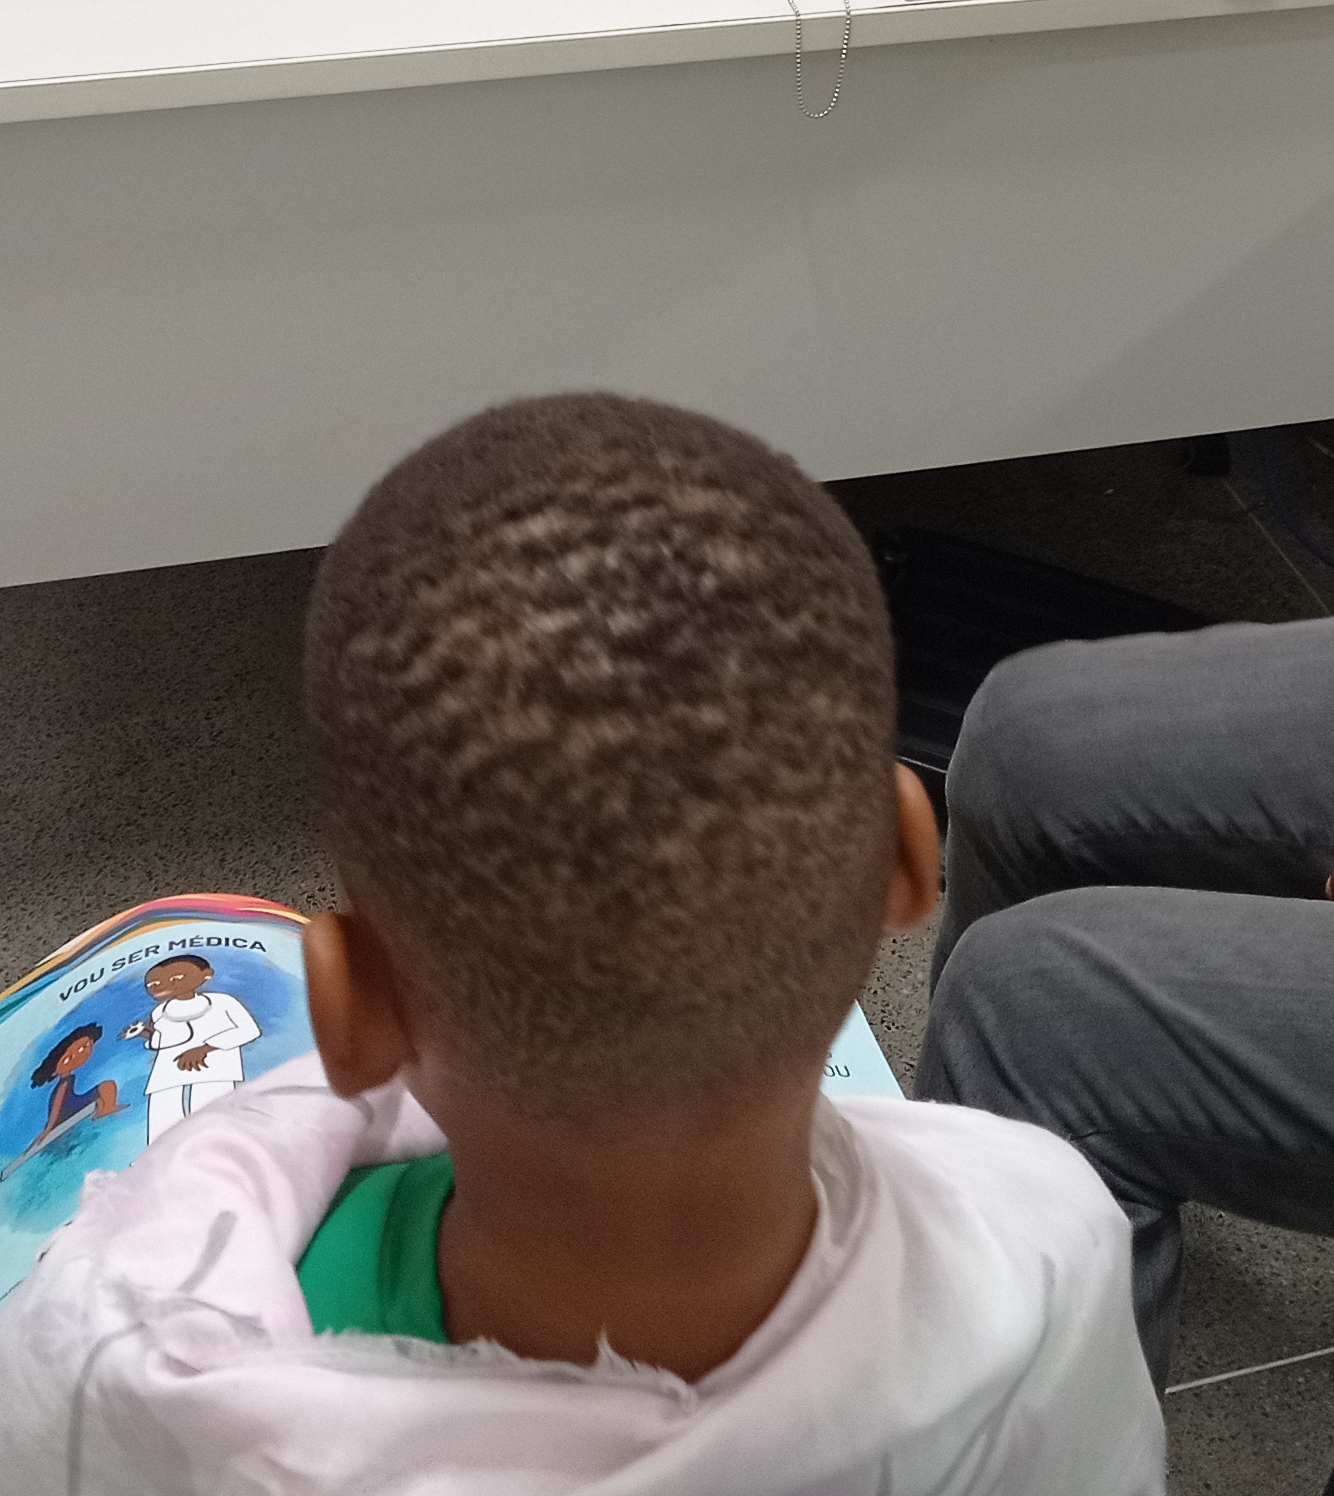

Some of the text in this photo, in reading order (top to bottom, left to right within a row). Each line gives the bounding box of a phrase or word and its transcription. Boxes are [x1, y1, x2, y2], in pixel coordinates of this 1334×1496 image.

[58, 934, 268, 1004] VOU SER MÉDICA
